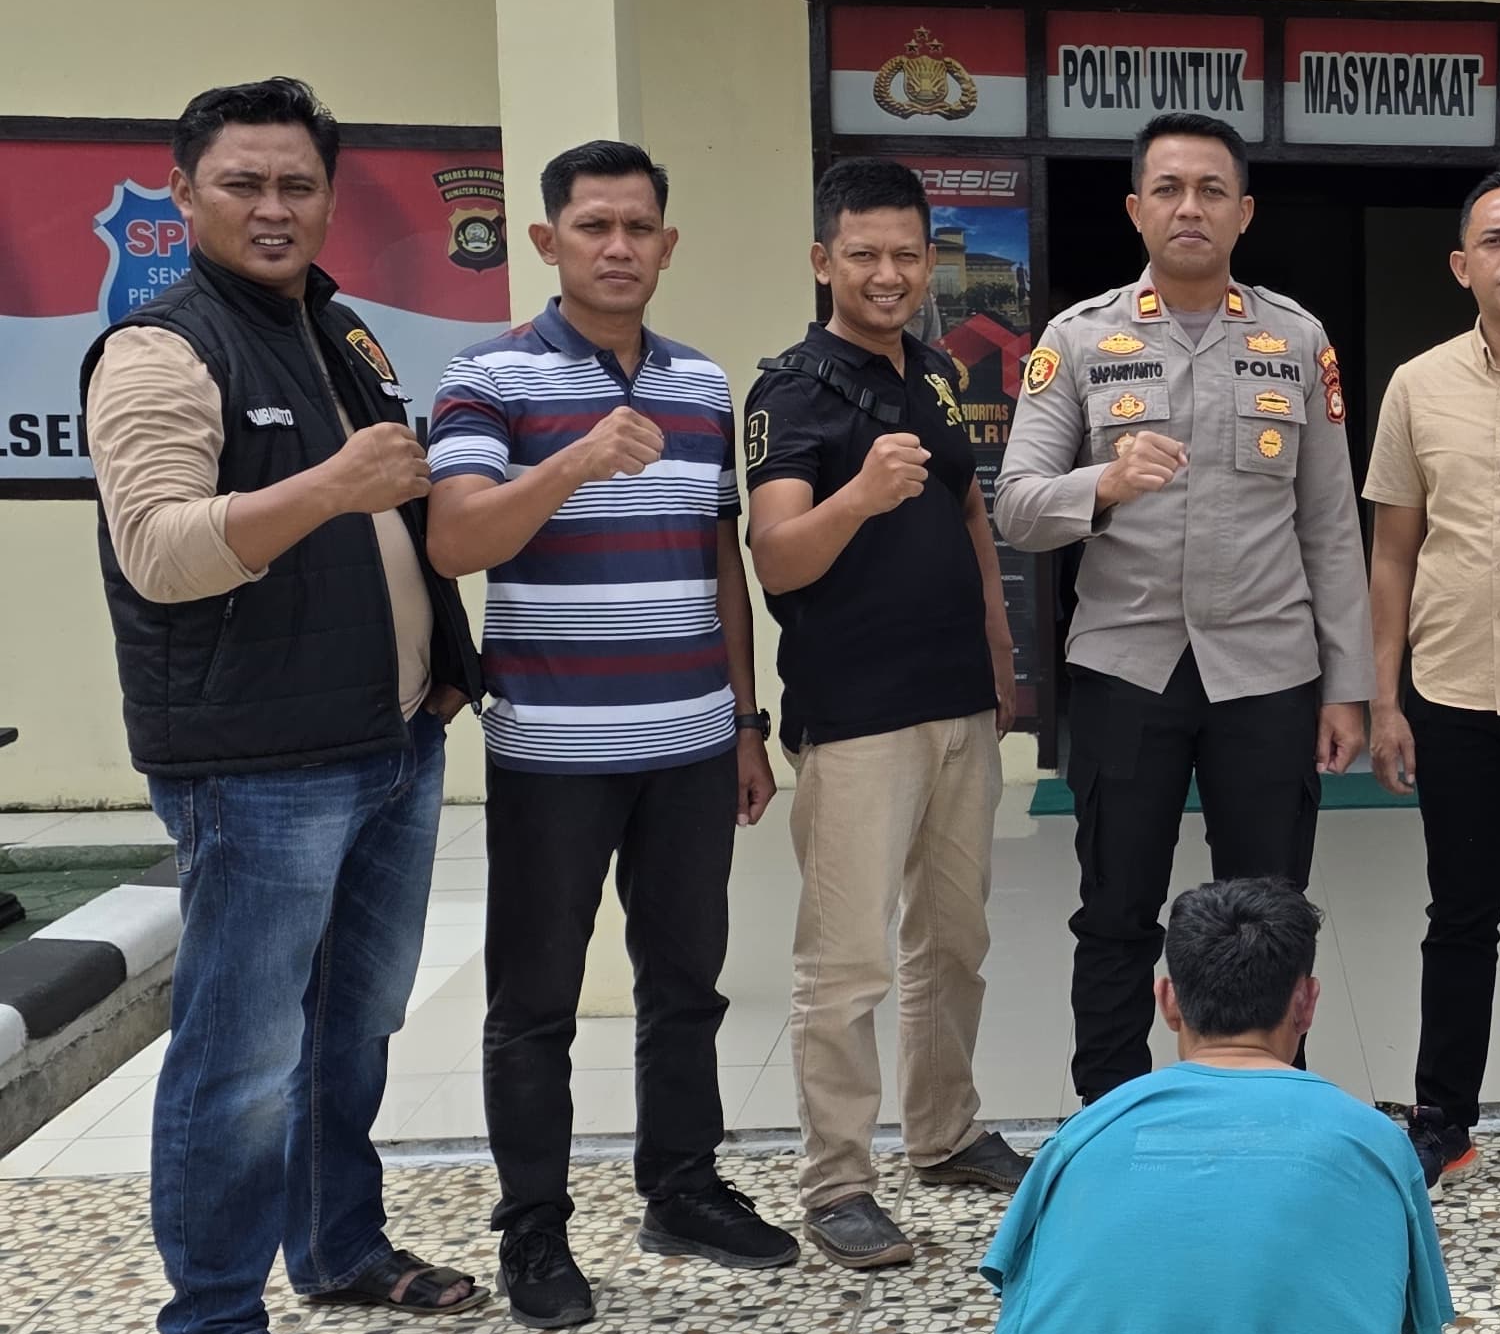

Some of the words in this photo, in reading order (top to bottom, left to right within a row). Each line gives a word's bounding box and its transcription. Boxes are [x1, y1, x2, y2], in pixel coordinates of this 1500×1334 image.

[1062, 48, 1140, 110] POLRI
[1149, 50, 1244, 112] UNTUK
[1303, 54, 1480, 117] MASYARAKAT
[1235, 359, 1300, 382] POLRI
